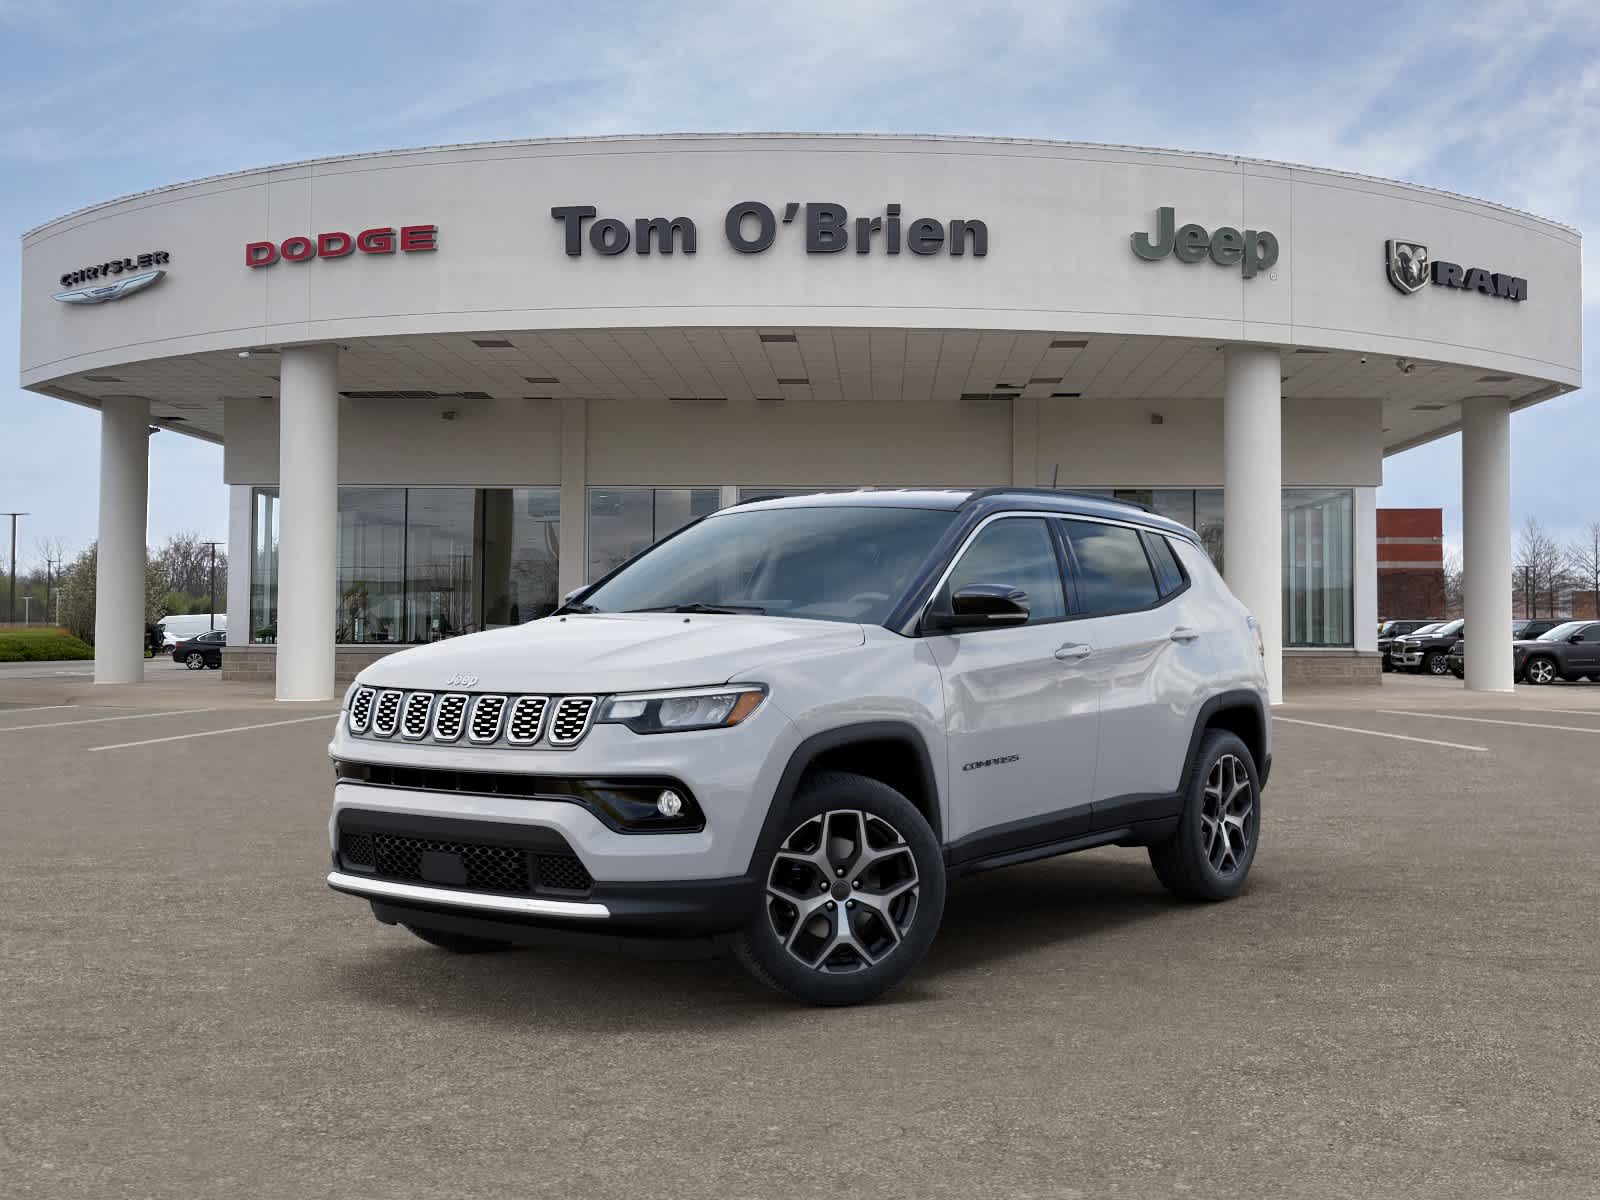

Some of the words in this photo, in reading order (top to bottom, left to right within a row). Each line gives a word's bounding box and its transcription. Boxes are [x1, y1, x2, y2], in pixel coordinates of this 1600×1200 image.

[245, 224, 437, 269] DODGE
[551, 204, 696, 256] Tom
[725, 201, 988, 256] O'Brien
[1131, 206, 1279, 279] Jeep
[60, 250, 170, 287] CHRYSLER
[1431, 261, 1527, 301] RAM
[446, 672, 479, 688] Jeep
